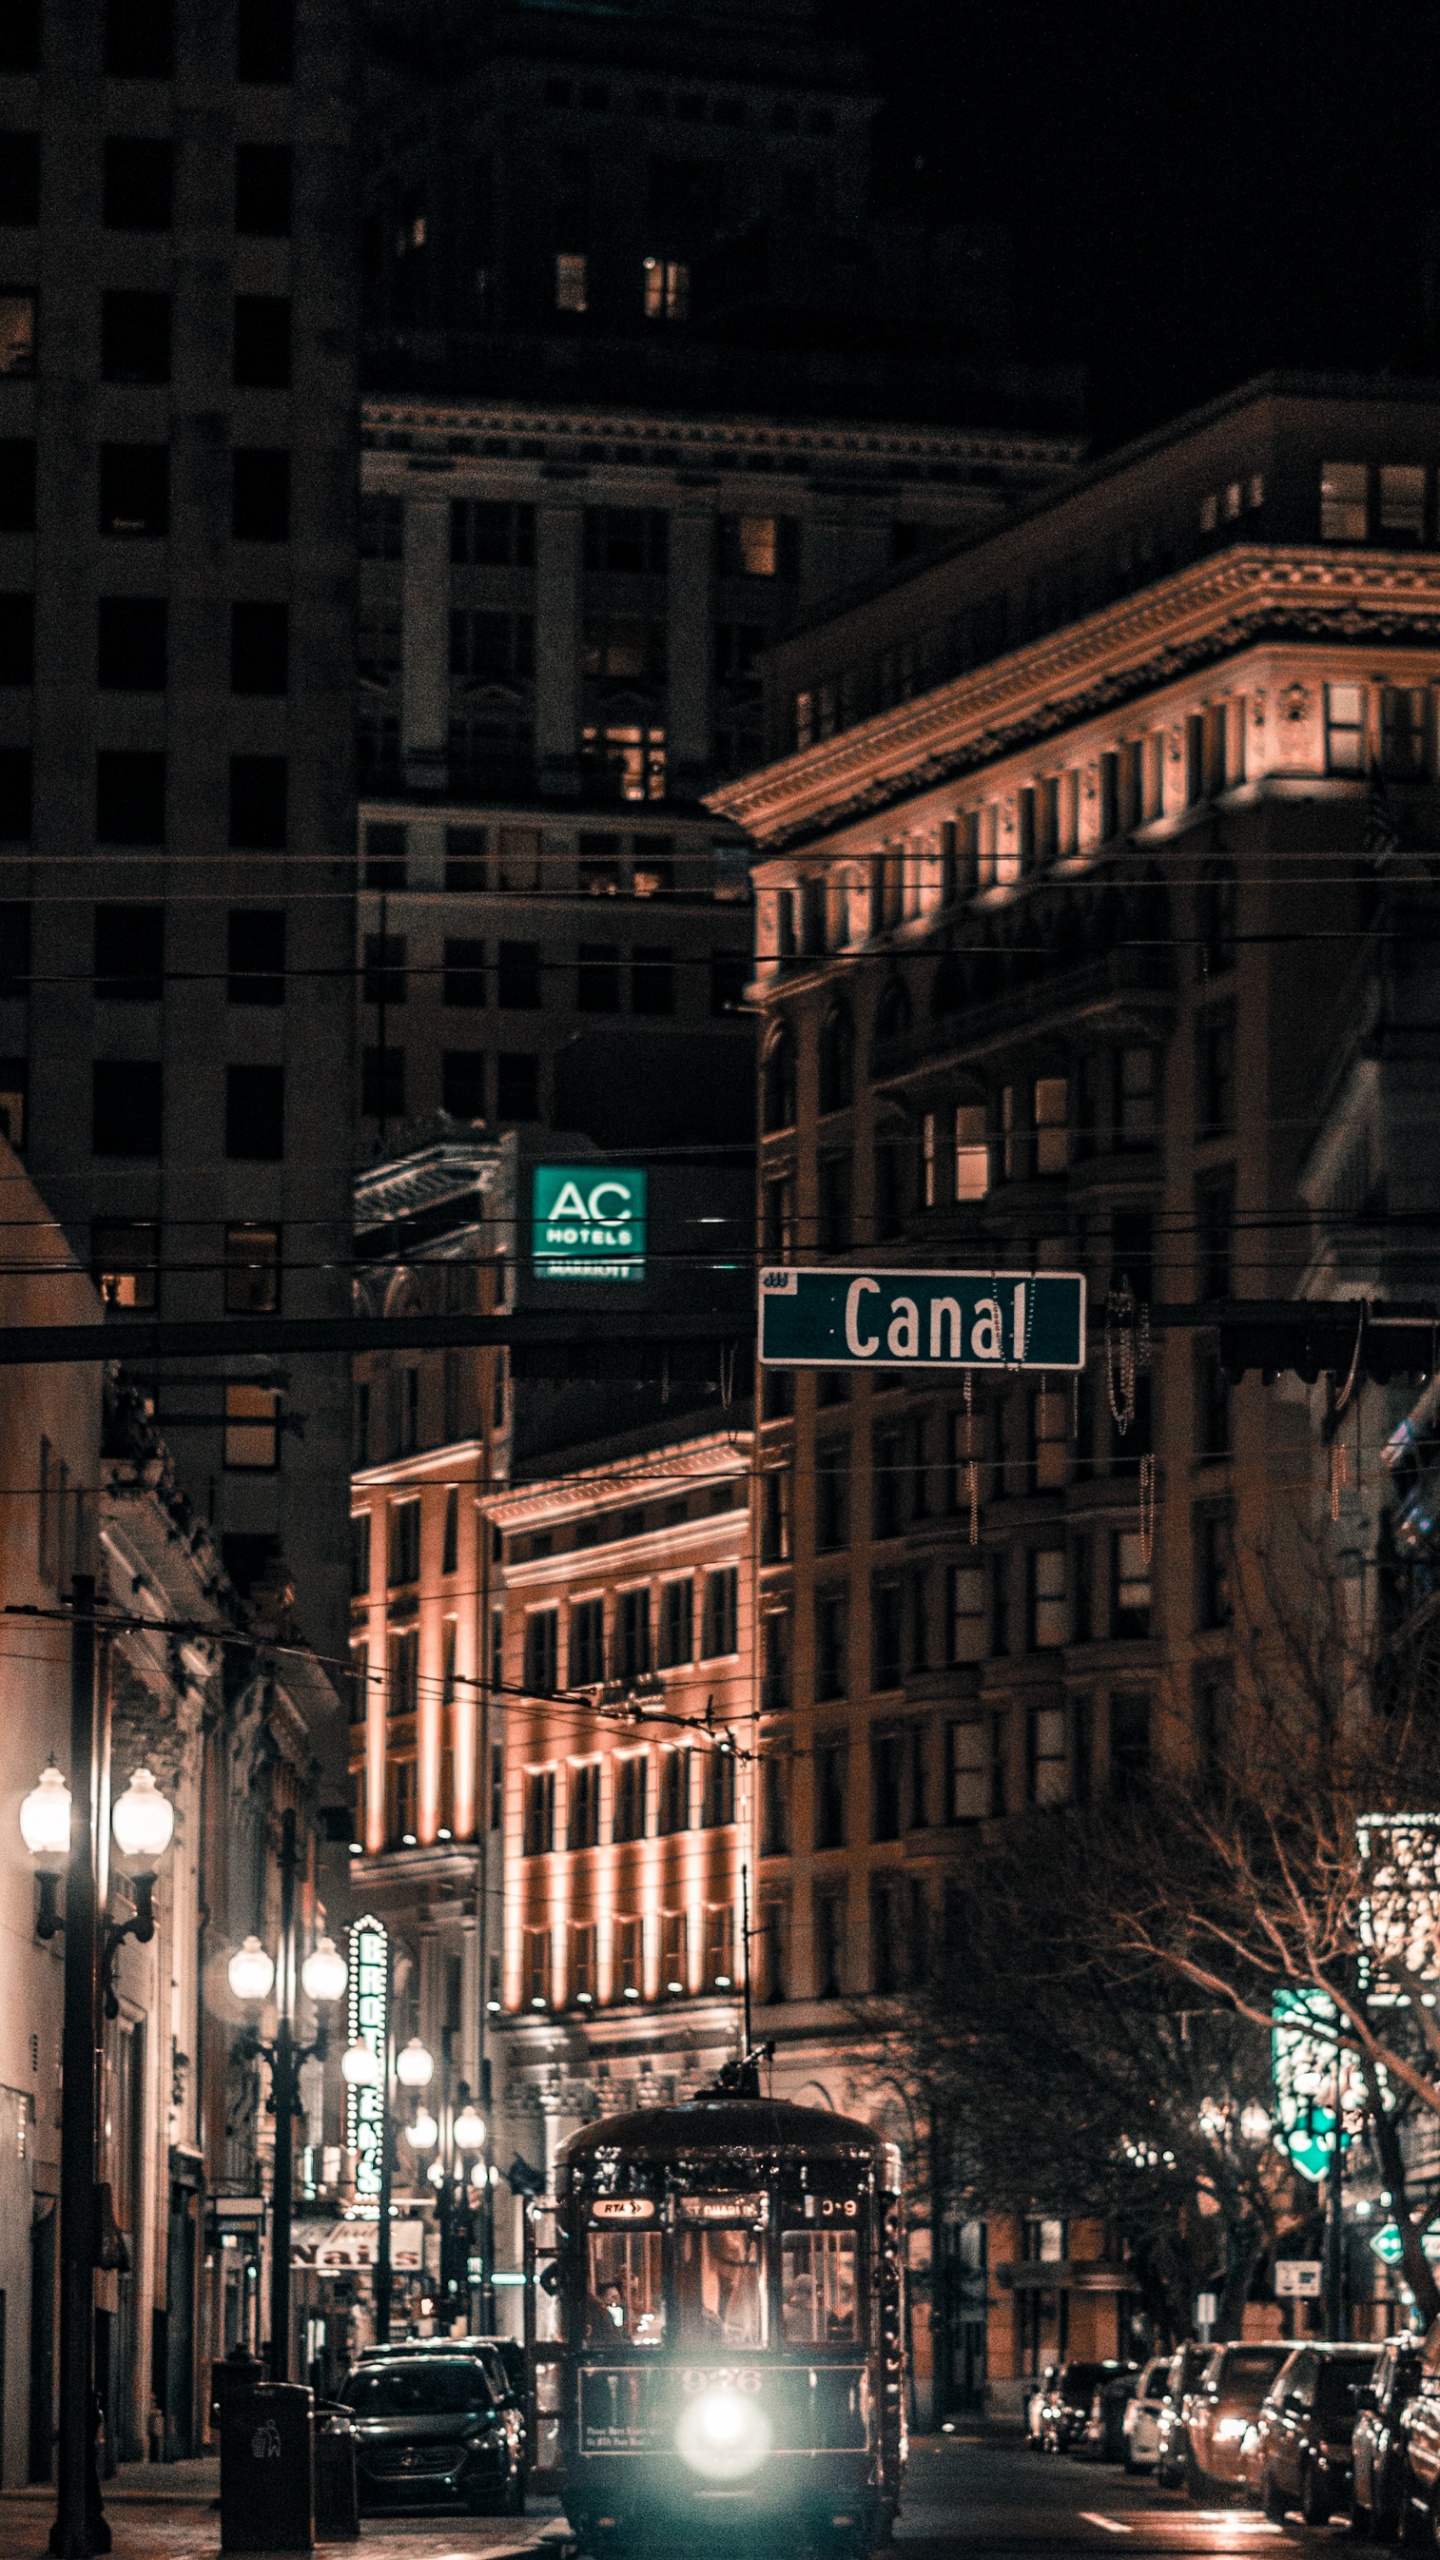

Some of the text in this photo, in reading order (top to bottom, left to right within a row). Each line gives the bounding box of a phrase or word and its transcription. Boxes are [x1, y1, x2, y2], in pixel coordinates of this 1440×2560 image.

[547, 1181, 632, 1228] AC
[546, 1229, 632, 1246] HOTELS
[844, 1277, 1027, 1360] Canal
[289, 2244, 419, 2266] Nais
